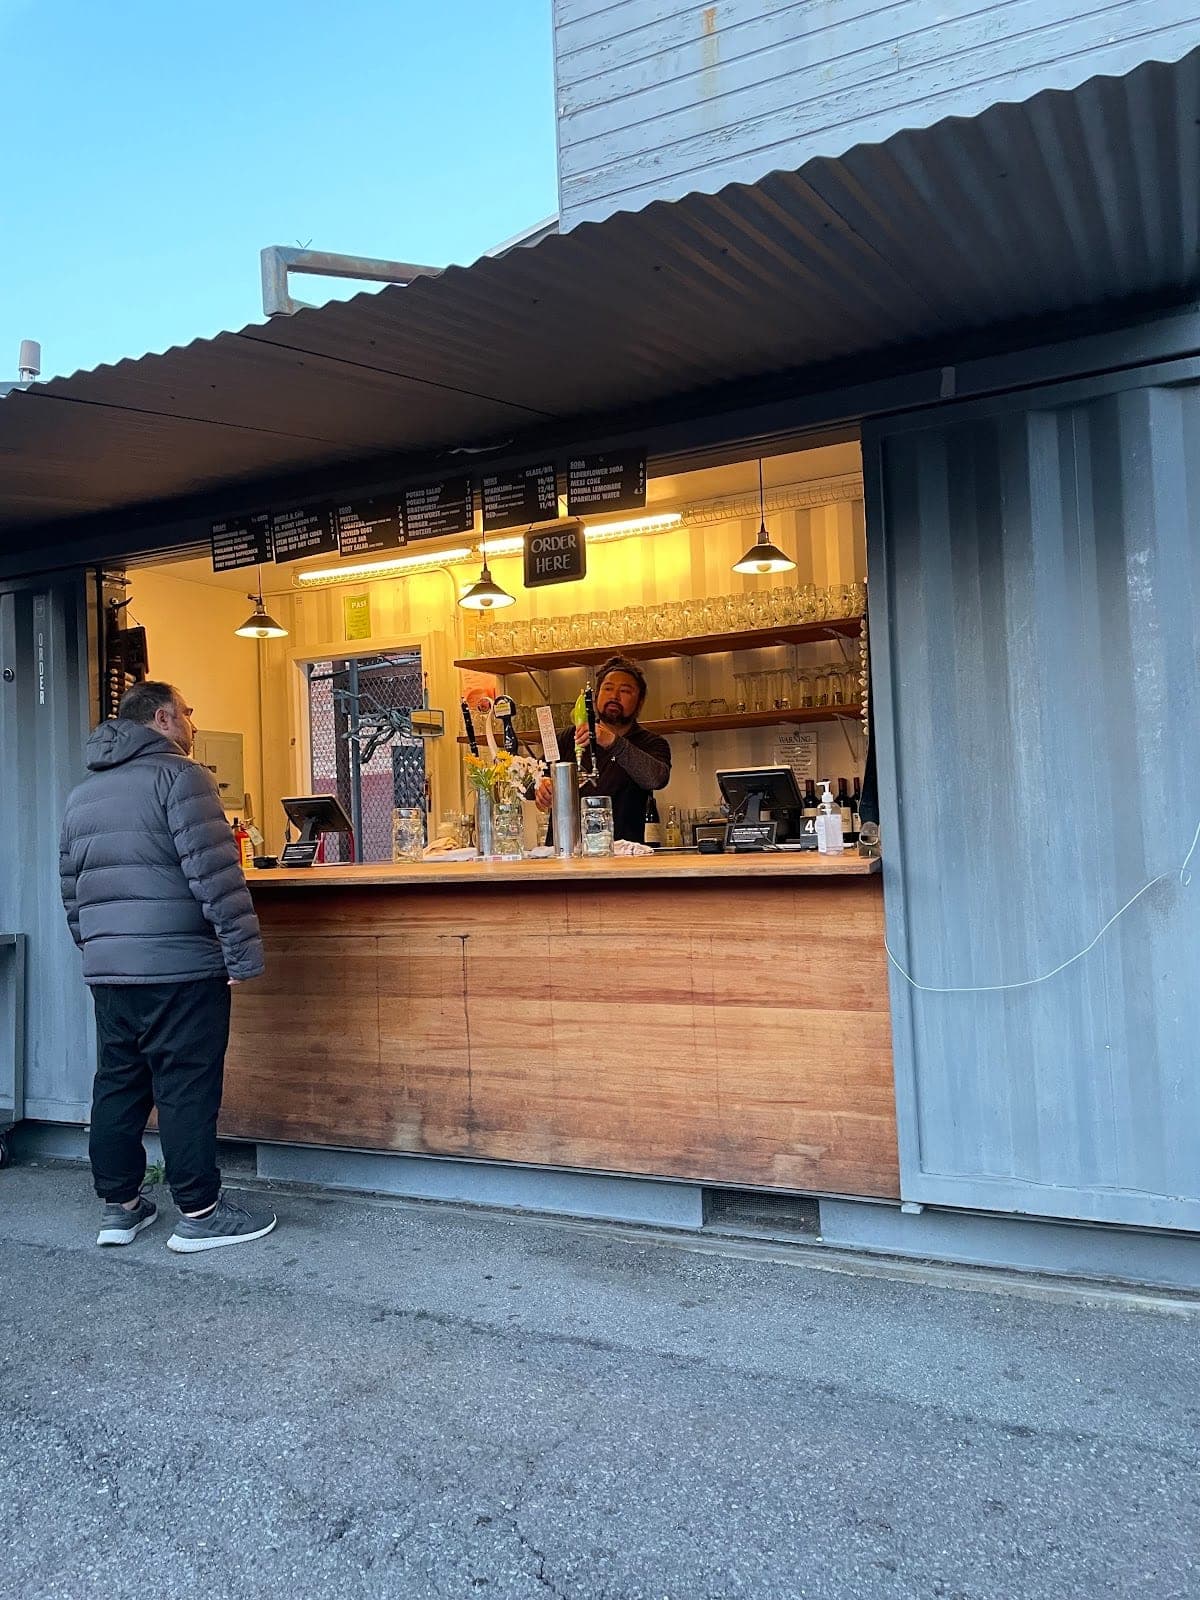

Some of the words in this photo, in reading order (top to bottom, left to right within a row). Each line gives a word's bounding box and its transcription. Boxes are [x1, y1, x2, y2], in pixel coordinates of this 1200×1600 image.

[570, 461, 585, 469] SODA
[570, 468, 608, 478] ELDERFLOWER
[587, 477, 601, 485] COKE
[484, 485, 512, 495] SPARKLING
[592, 483, 621, 493] LEMONADE
[406, 490, 425, 498] POTATO
[406, 498, 425, 506] POTATO
[485, 495, 501, 503] WHITE
[570, 495, 601, 503] SPARKLING
[354, 543, 368, 551] SALAD
[531, 534, 577, 554] ORDER
[535, 553, 571, 574] HERE
[38, 632, 46, 705] ORDER
